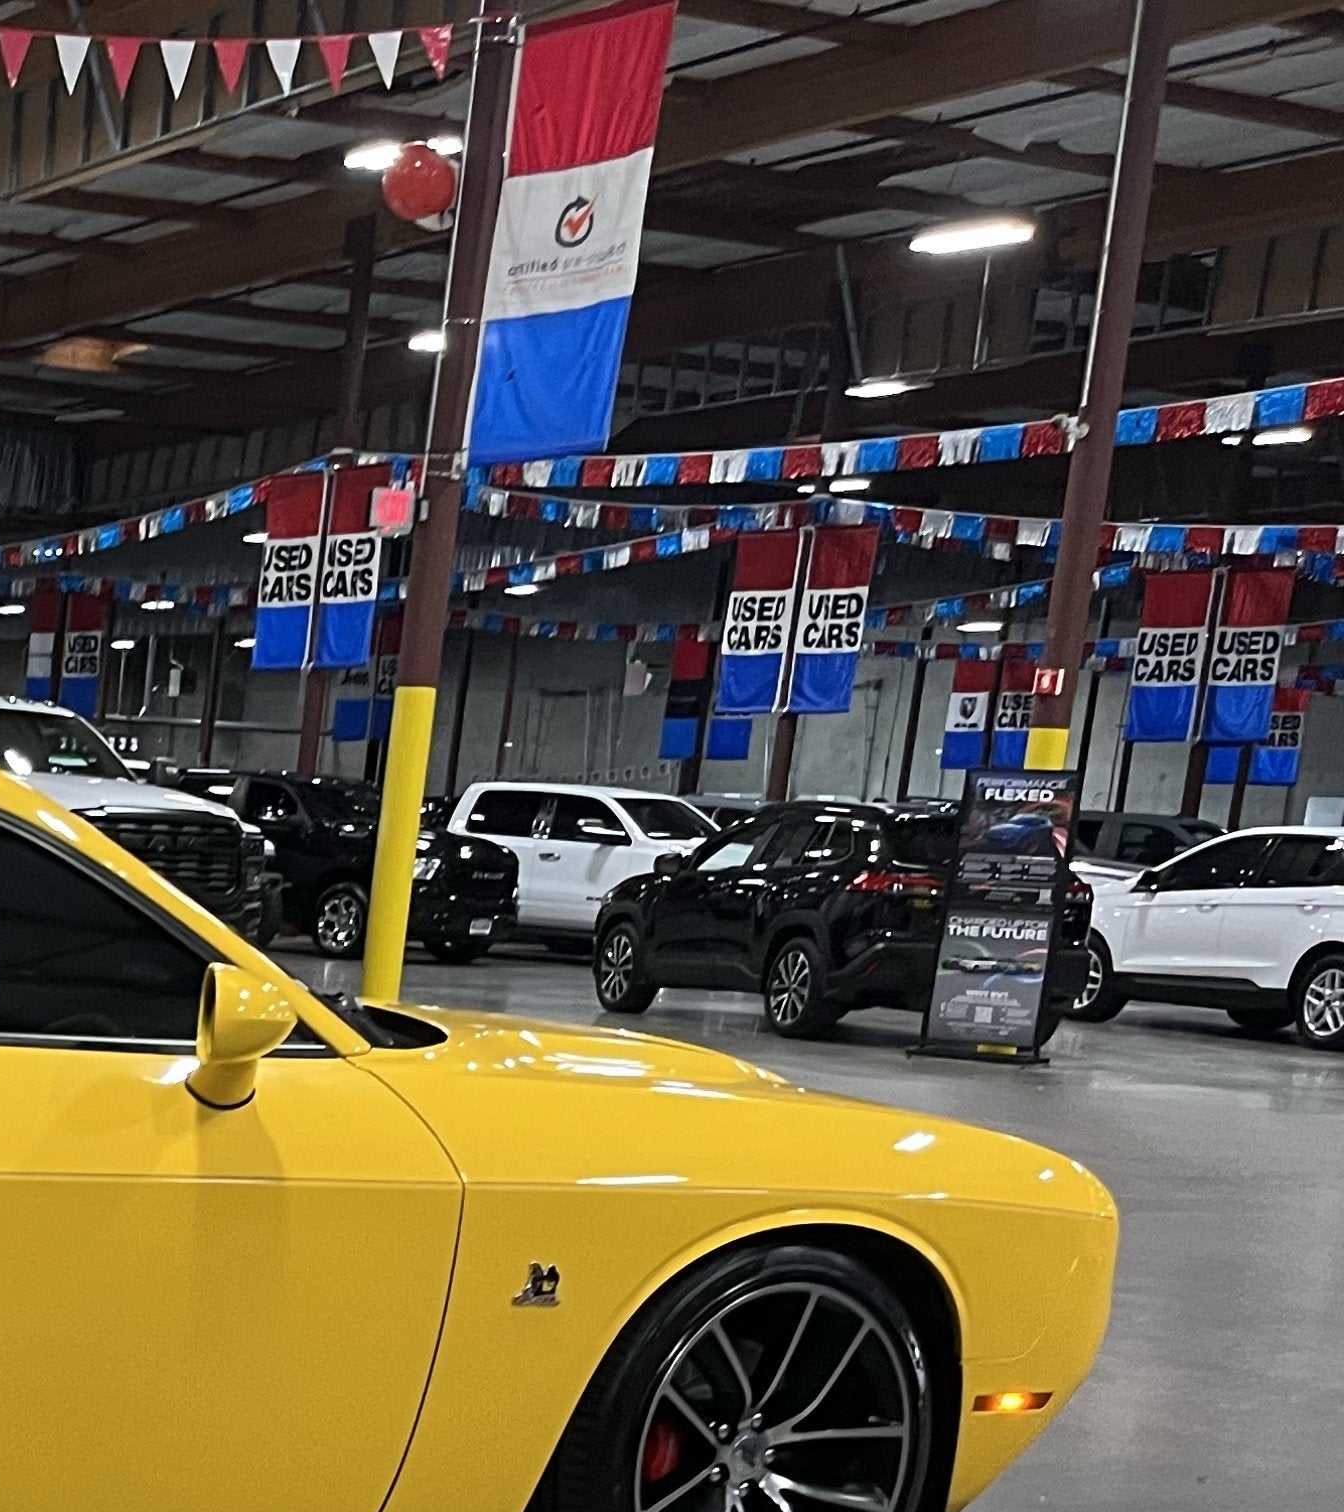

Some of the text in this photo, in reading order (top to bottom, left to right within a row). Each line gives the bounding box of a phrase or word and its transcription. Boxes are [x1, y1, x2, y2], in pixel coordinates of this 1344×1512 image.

[733, 596, 786, 622] USED
[727, 624, 782, 650] CARS
[803, 622, 861, 648] CARS
[1138, 632, 1199, 657] USED
[1217, 631, 1280, 655] USED
[1134, 658, 1196, 682] CARS
[1213, 658, 1275, 682] CARS
[1002, 694, 1033, 711] USE
[997, 713, 1030, 728] CAR
[1271, 714, 1301, 730] SED
[1269, 732, 1299, 747] ARS
[985, 788, 1054, 803] FLEXED
[948, 924, 1047, 941] THE FUTURE
